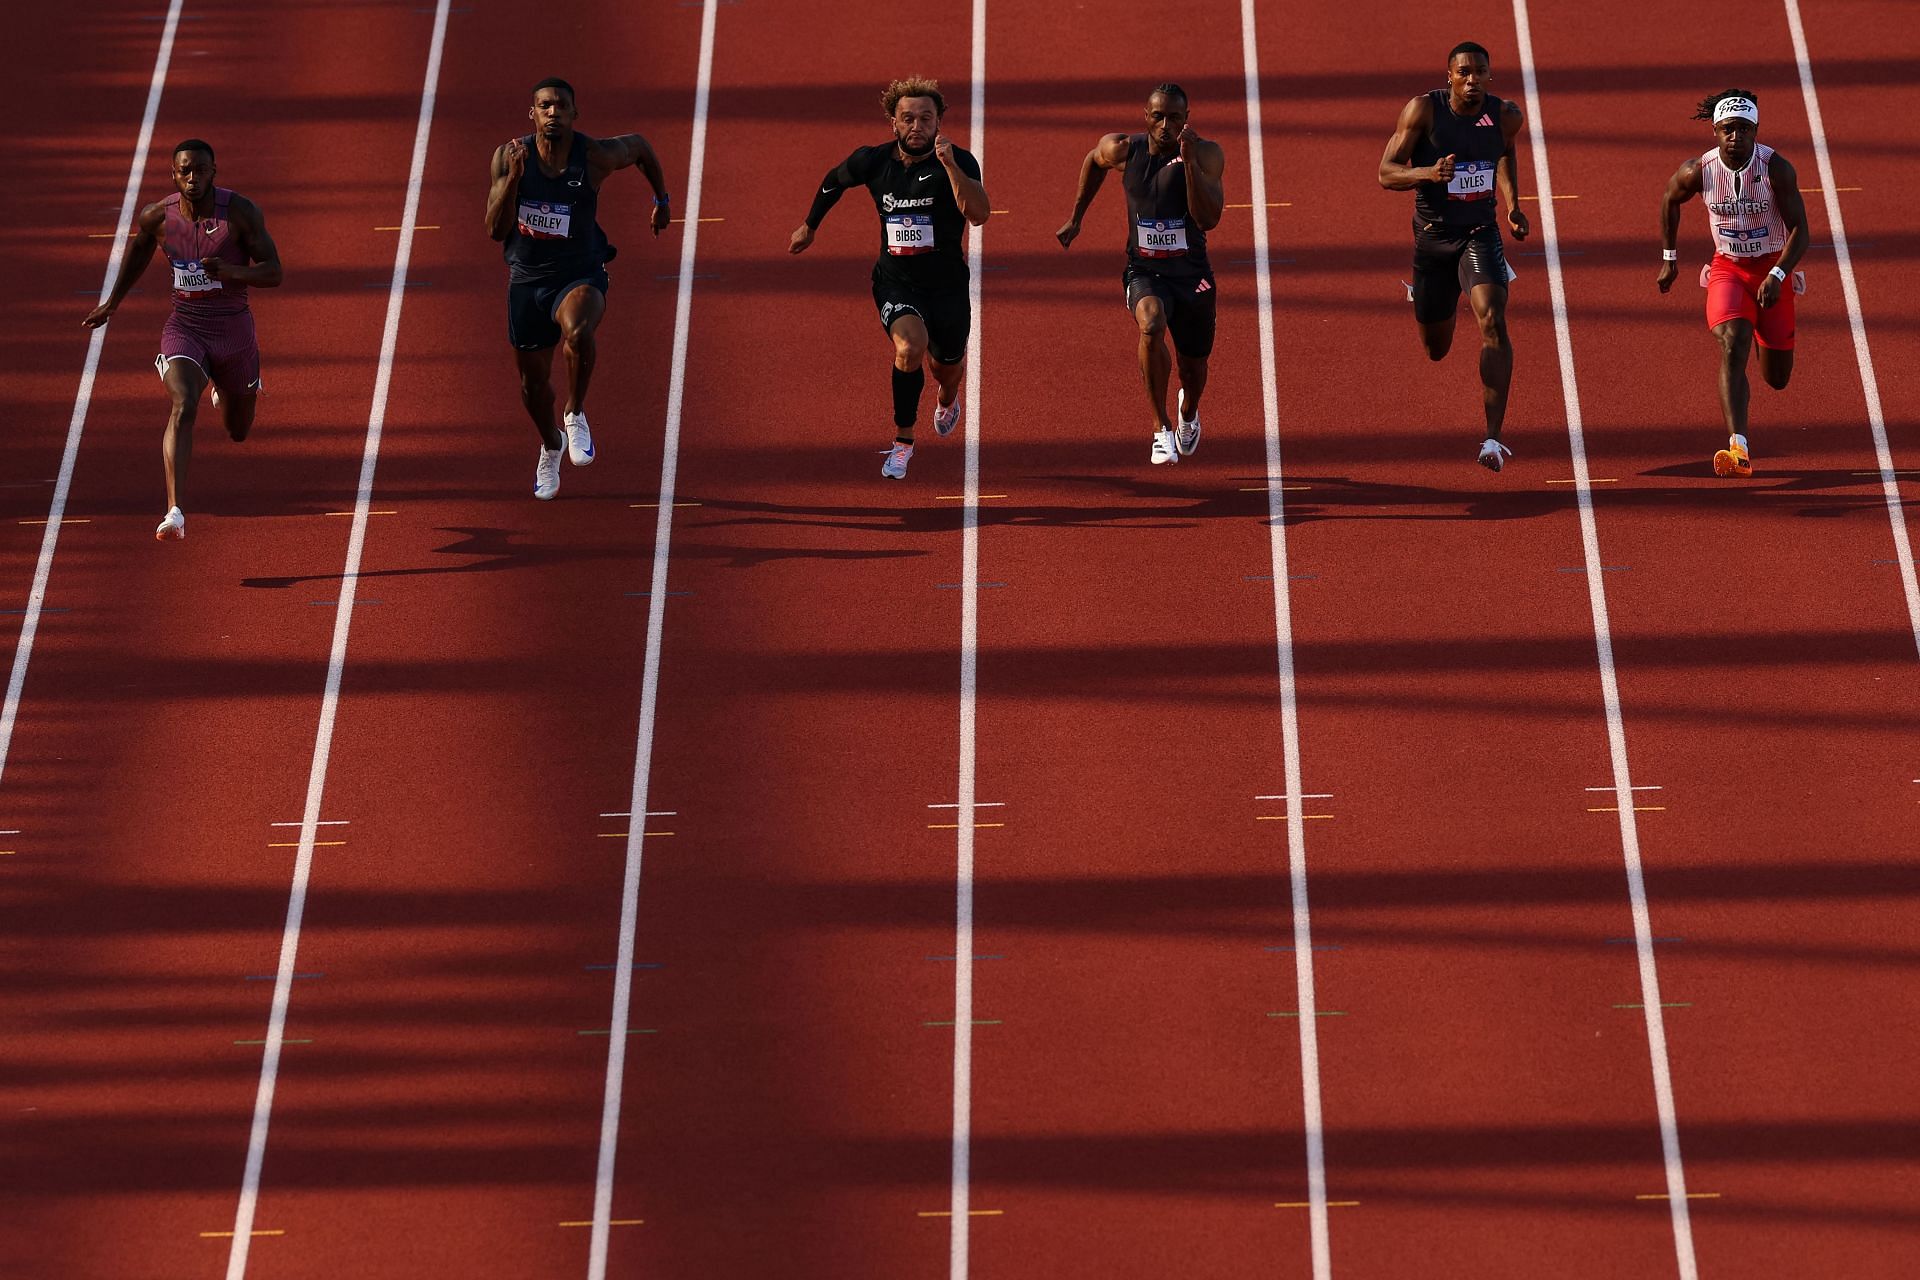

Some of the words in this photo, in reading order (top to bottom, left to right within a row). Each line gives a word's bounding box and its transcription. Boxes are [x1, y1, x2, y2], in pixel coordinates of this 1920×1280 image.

[1719, 98, 1747, 110] GOD
[1720, 105, 1754, 117] FIRST
[1460, 175, 1485, 189] LYLES
[883, 193, 934, 212] SHARKS
[1709, 200, 1769, 215] STRIDERS
[526, 213, 562, 229] KERLEY
[896, 230, 922, 242] BIBBS
[1146, 234, 1177, 246] BAKER
[1729, 242, 1762, 253] MILLER
[179, 273, 215, 288] LINDSE
